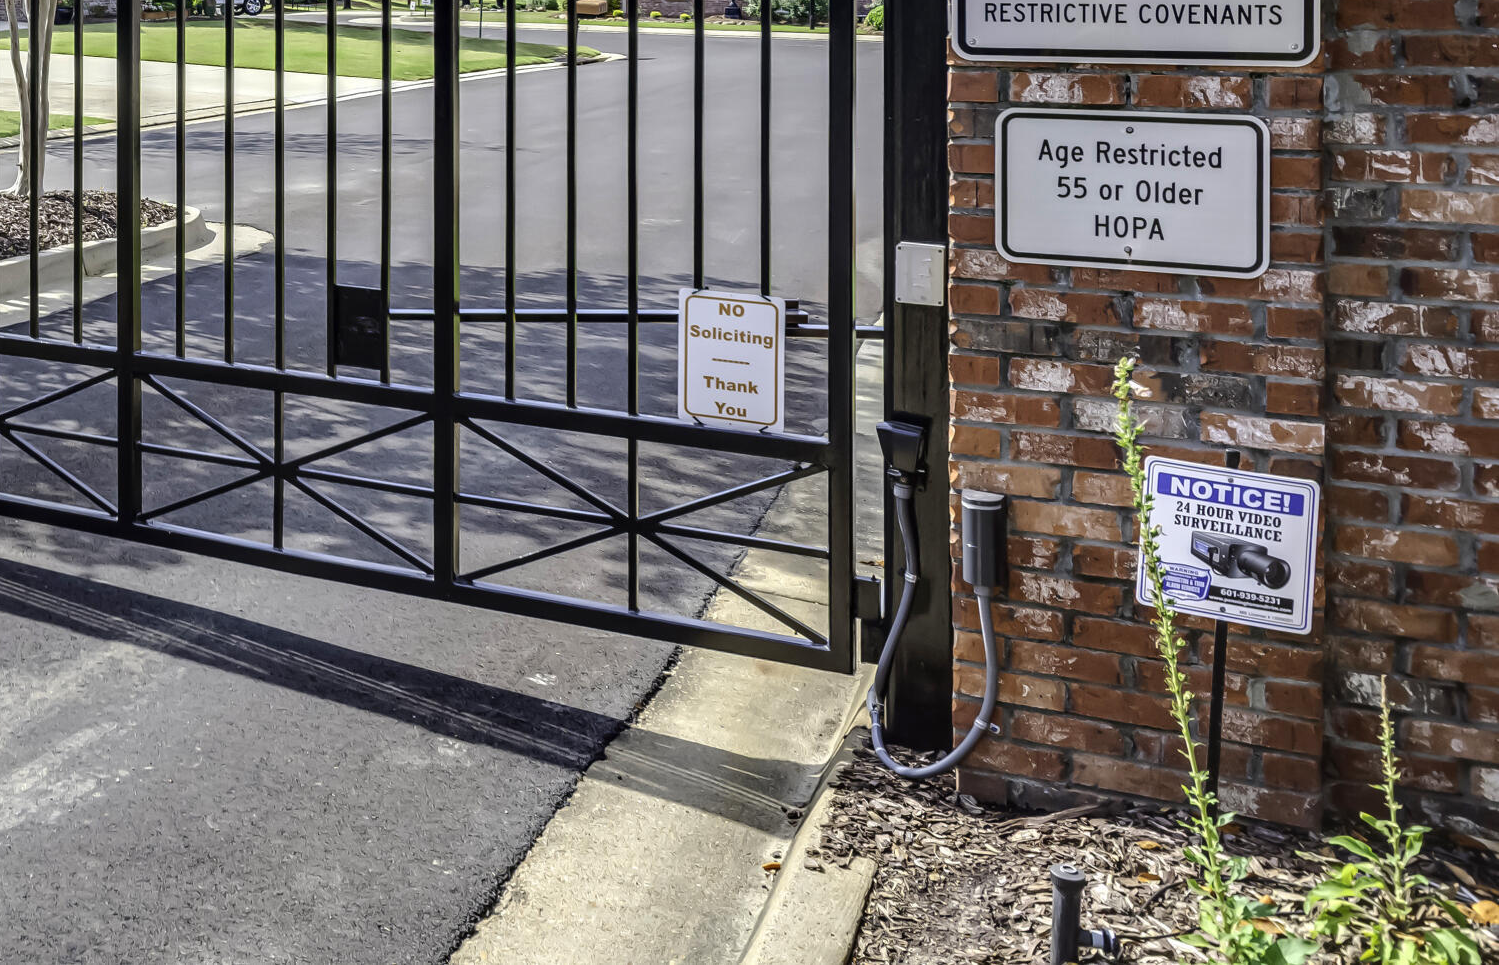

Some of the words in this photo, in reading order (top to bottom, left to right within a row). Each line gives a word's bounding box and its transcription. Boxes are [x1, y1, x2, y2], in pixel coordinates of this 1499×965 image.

[984, 3, 1127, 24] RESTRICTIVE
[1138, 4, 1283, 25] COVENANTS
[1038, 139, 1084, 168] Age
[1096, 141, 1222, 169] Restricted
[1057, 177, 1088, 199] 55
[1100, 185, 1124, 201] or
[1136, 180, 1204, 205] Older
[1095, 215, 1164, 240] HOPA
[719, 303, 744, 318] NO
[690, 325, 773, 349] Soliciting
[703, 376, 758, 394] Thank
[715, 401, 747, 417] You
[1170, 476, 1291, 513] NOTICE!
[1176, 501, 1190, 513] 24
[1196, 504, 1234, 521] HOUR
[1238, 511, 1281, 528] VIDEO
[1174, 514, 1282, 542] SURVEILLANCE
[1220, 589, 1281, 605] 601-939-5231
